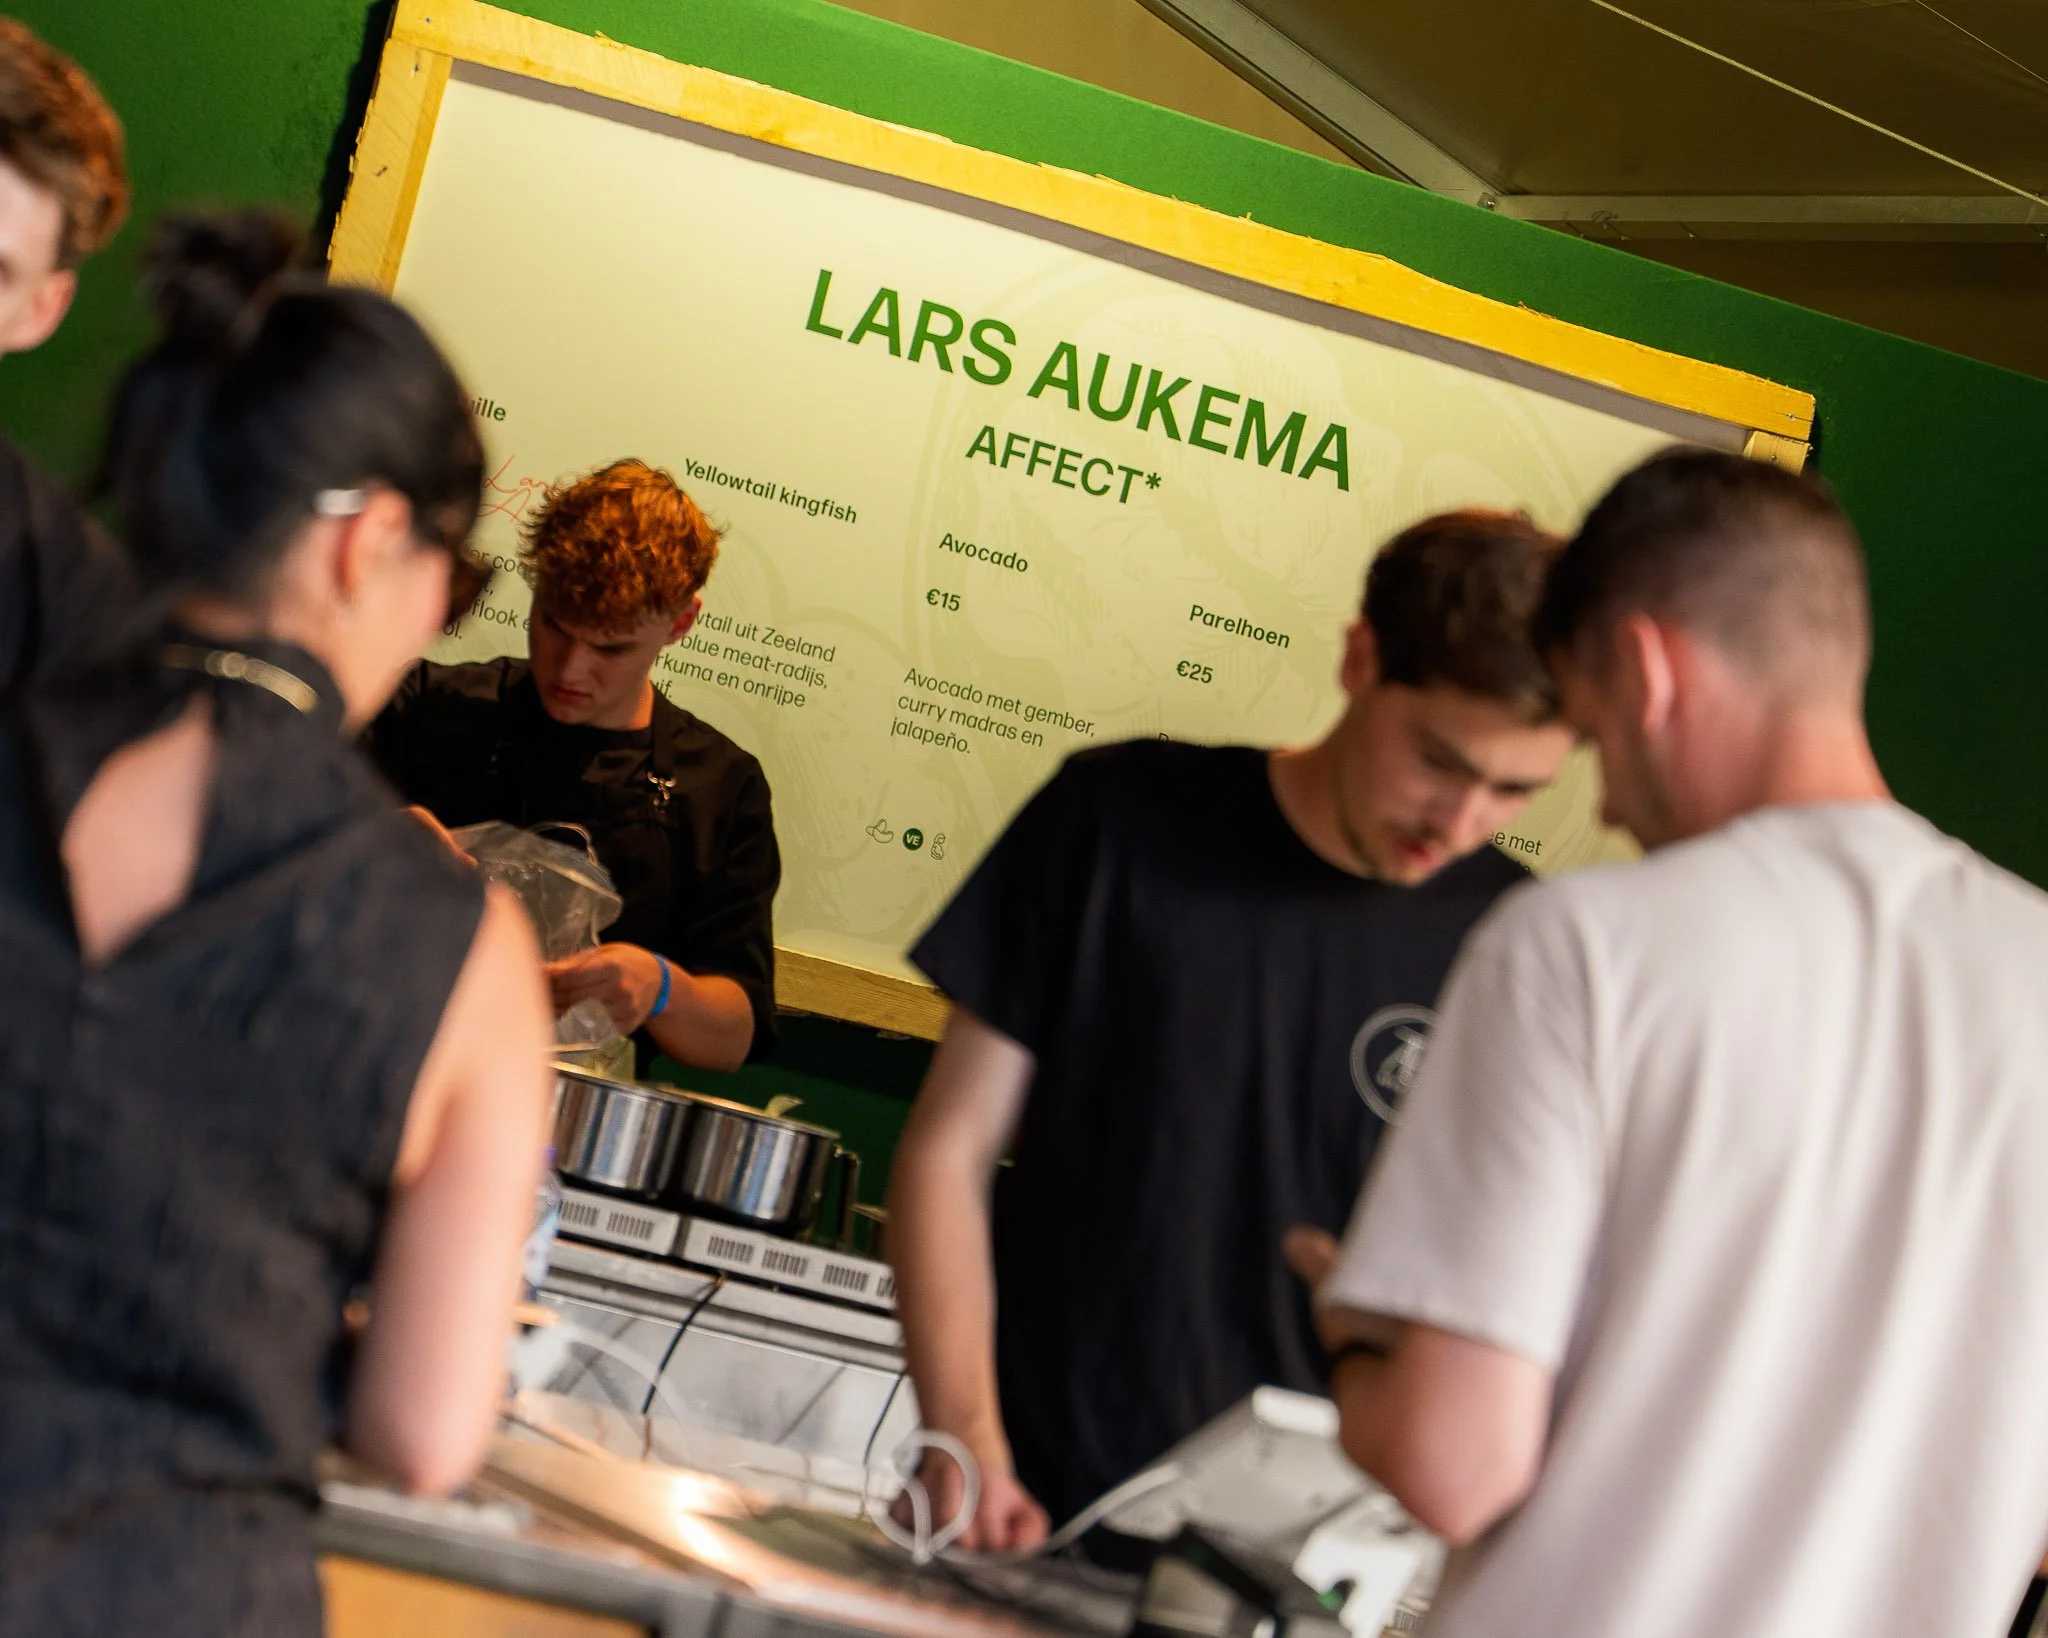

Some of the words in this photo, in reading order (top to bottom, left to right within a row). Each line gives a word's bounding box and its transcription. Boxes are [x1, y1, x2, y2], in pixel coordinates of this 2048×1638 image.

[805, 268, 1017, 386] LARS
[1027, 340, 1350, 492] AUKEMA
[471, 397, 507, 422] ille
[684, 457, 777, 501] Yellowtail
[778, 486, 857, 524] kingfish
[938, 532, 1029, 573] Avocado
[471, 599, 518, 628] flook
[925, 588, 962, 612] €15
[734, 623, 758, 642] uit
[760, 627, 836, 663] Zeeland
[1189, 604, 1291, 649] Parelhoen
[654, 653, 714, 682] rkuma
[716, 671, 740, 690] en
[742, 678, 806, 708] onrijpe
[680, 634, 720, 657] blue
[722, 644, 828, 690] meat-radijs,
[1176, 660, 1214, 684] €25
[897, 695, 948, 723] curry
[949, 708, 1018, 741] madras
[1020, 730, 1044, 748] en
[903, 667, 984, 705] Avocado
[985, 693, 1022, 716] met
[1024, 703, 1096, 738] gember,
[890, 716, 971, 755] jalapeño.
[1508, 835, 1543, 856] met
